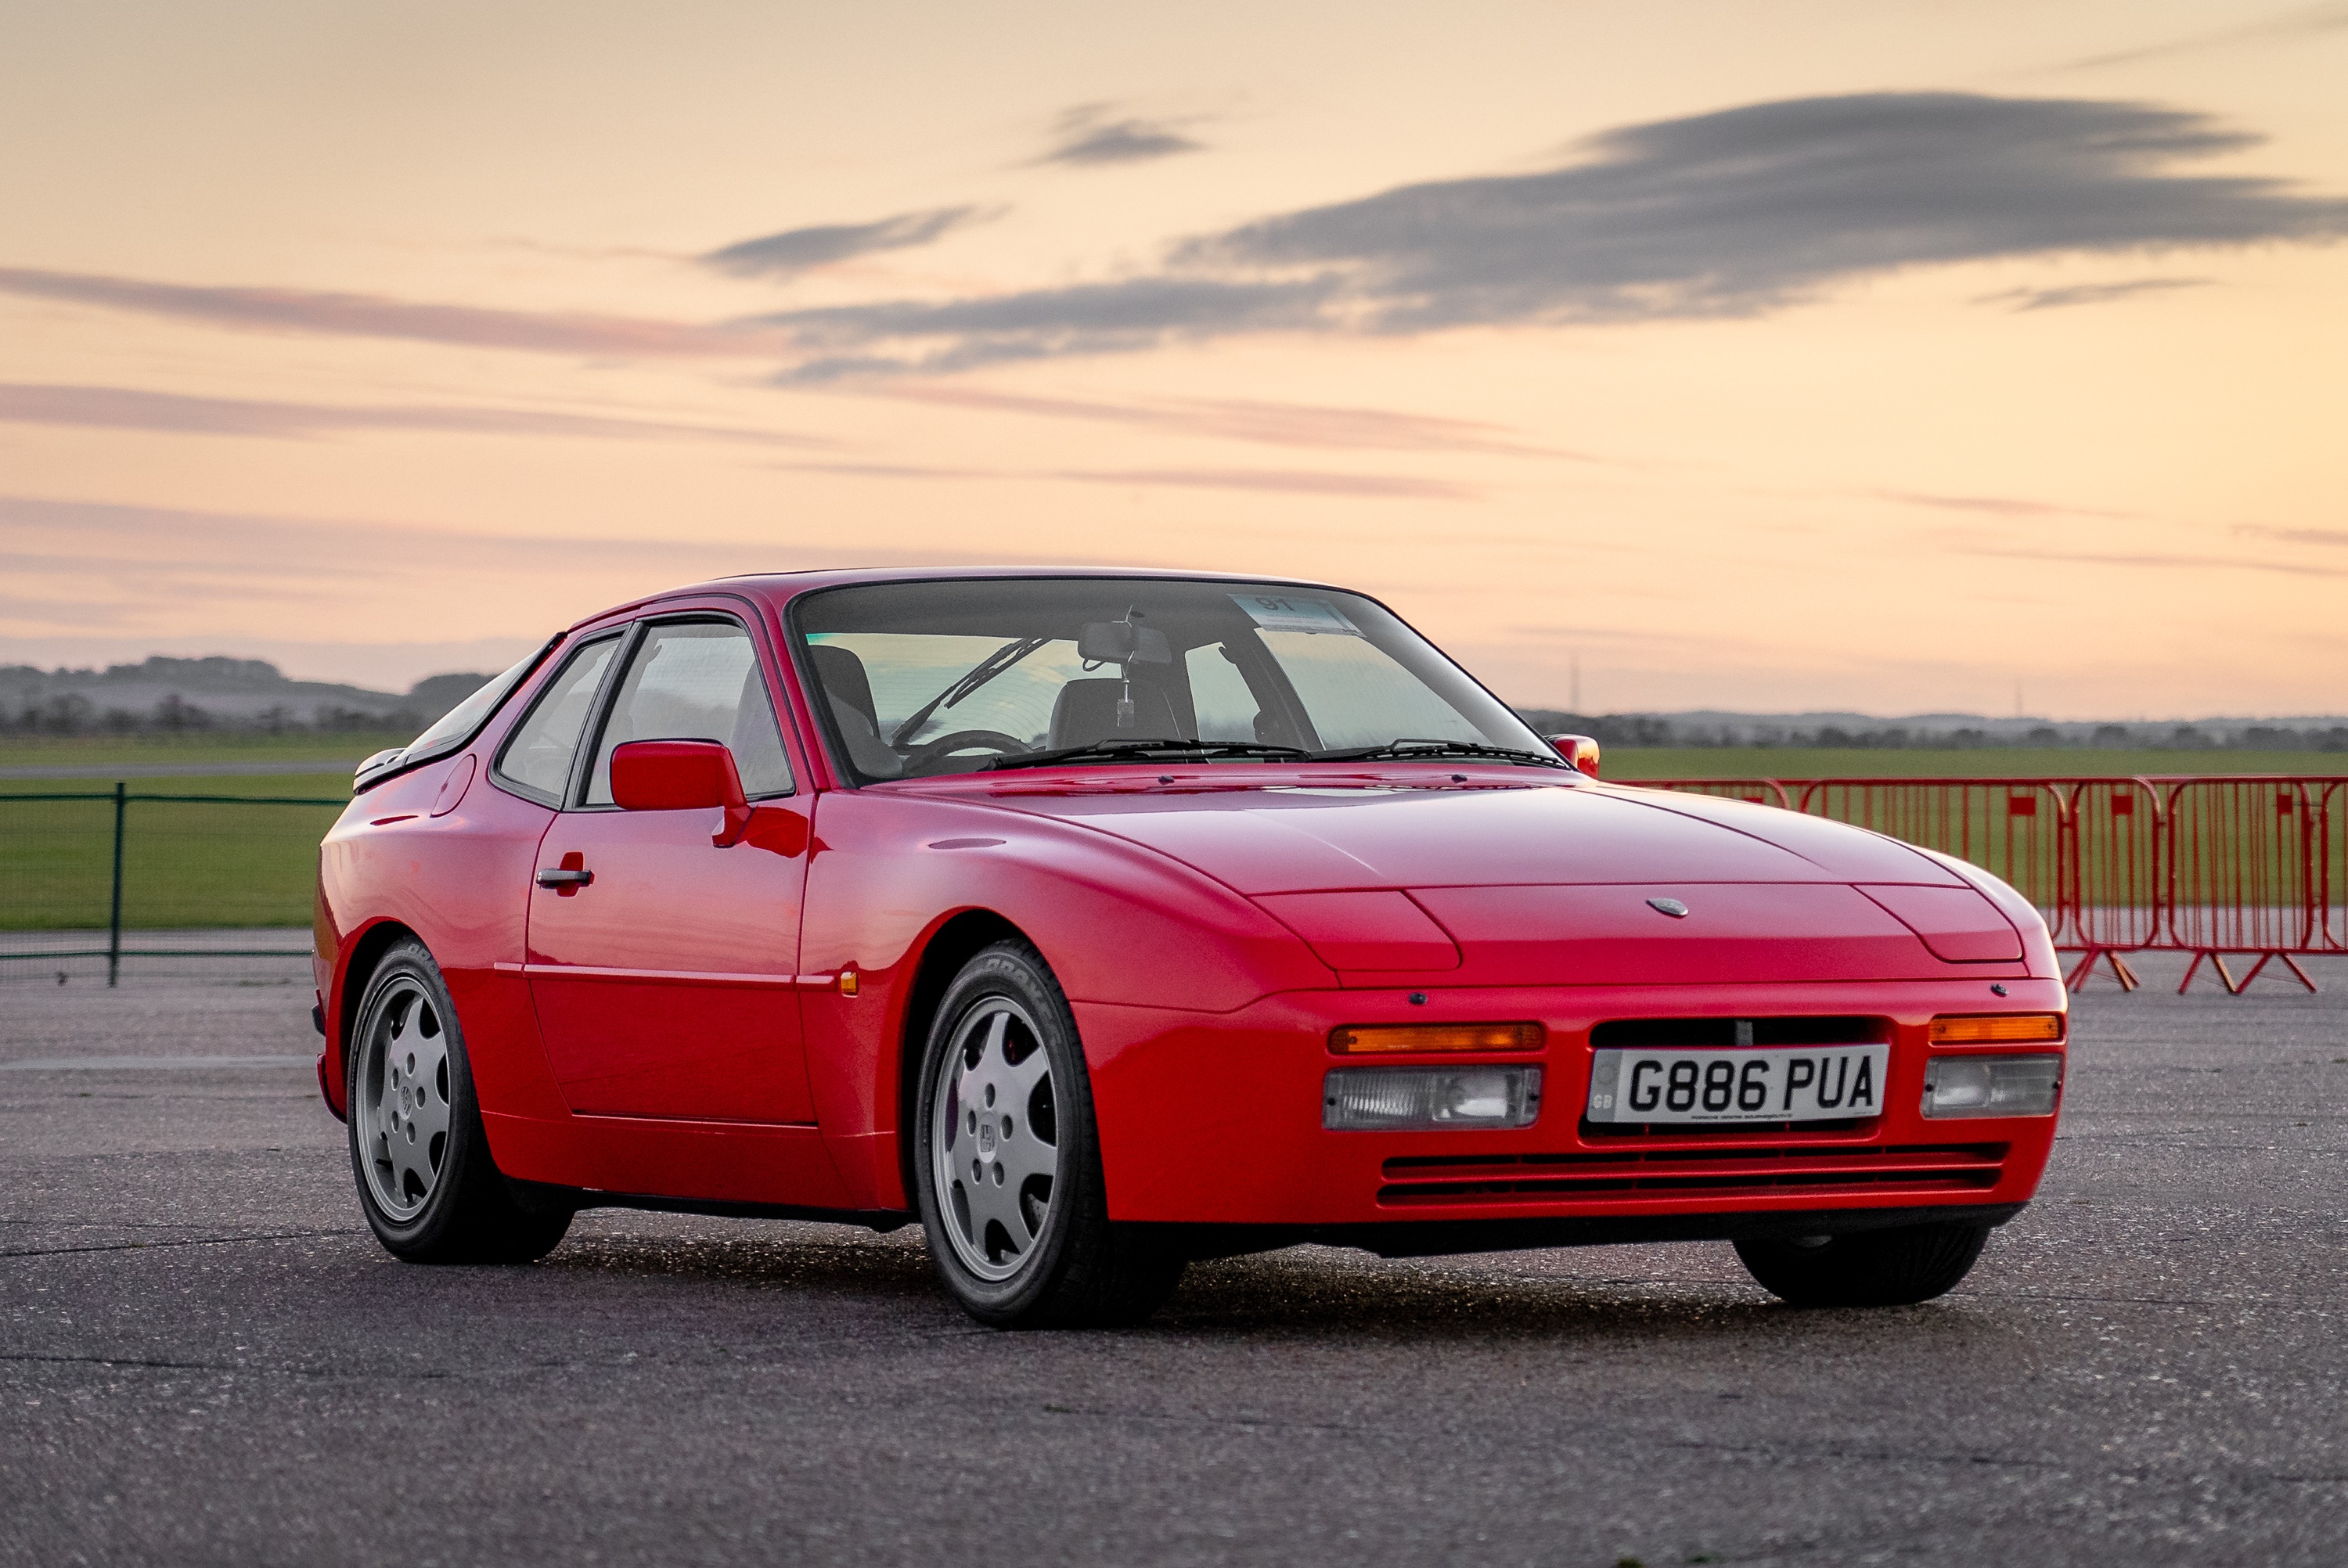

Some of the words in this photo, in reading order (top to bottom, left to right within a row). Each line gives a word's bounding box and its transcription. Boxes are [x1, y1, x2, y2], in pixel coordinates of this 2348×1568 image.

[1255, 597, 1295, 611] 91
[1630, 1059, 1770, 1112] G886
[1783, 1056, 1873, 1110] PUA
[1593, 1093, 1613, 1109] GB
